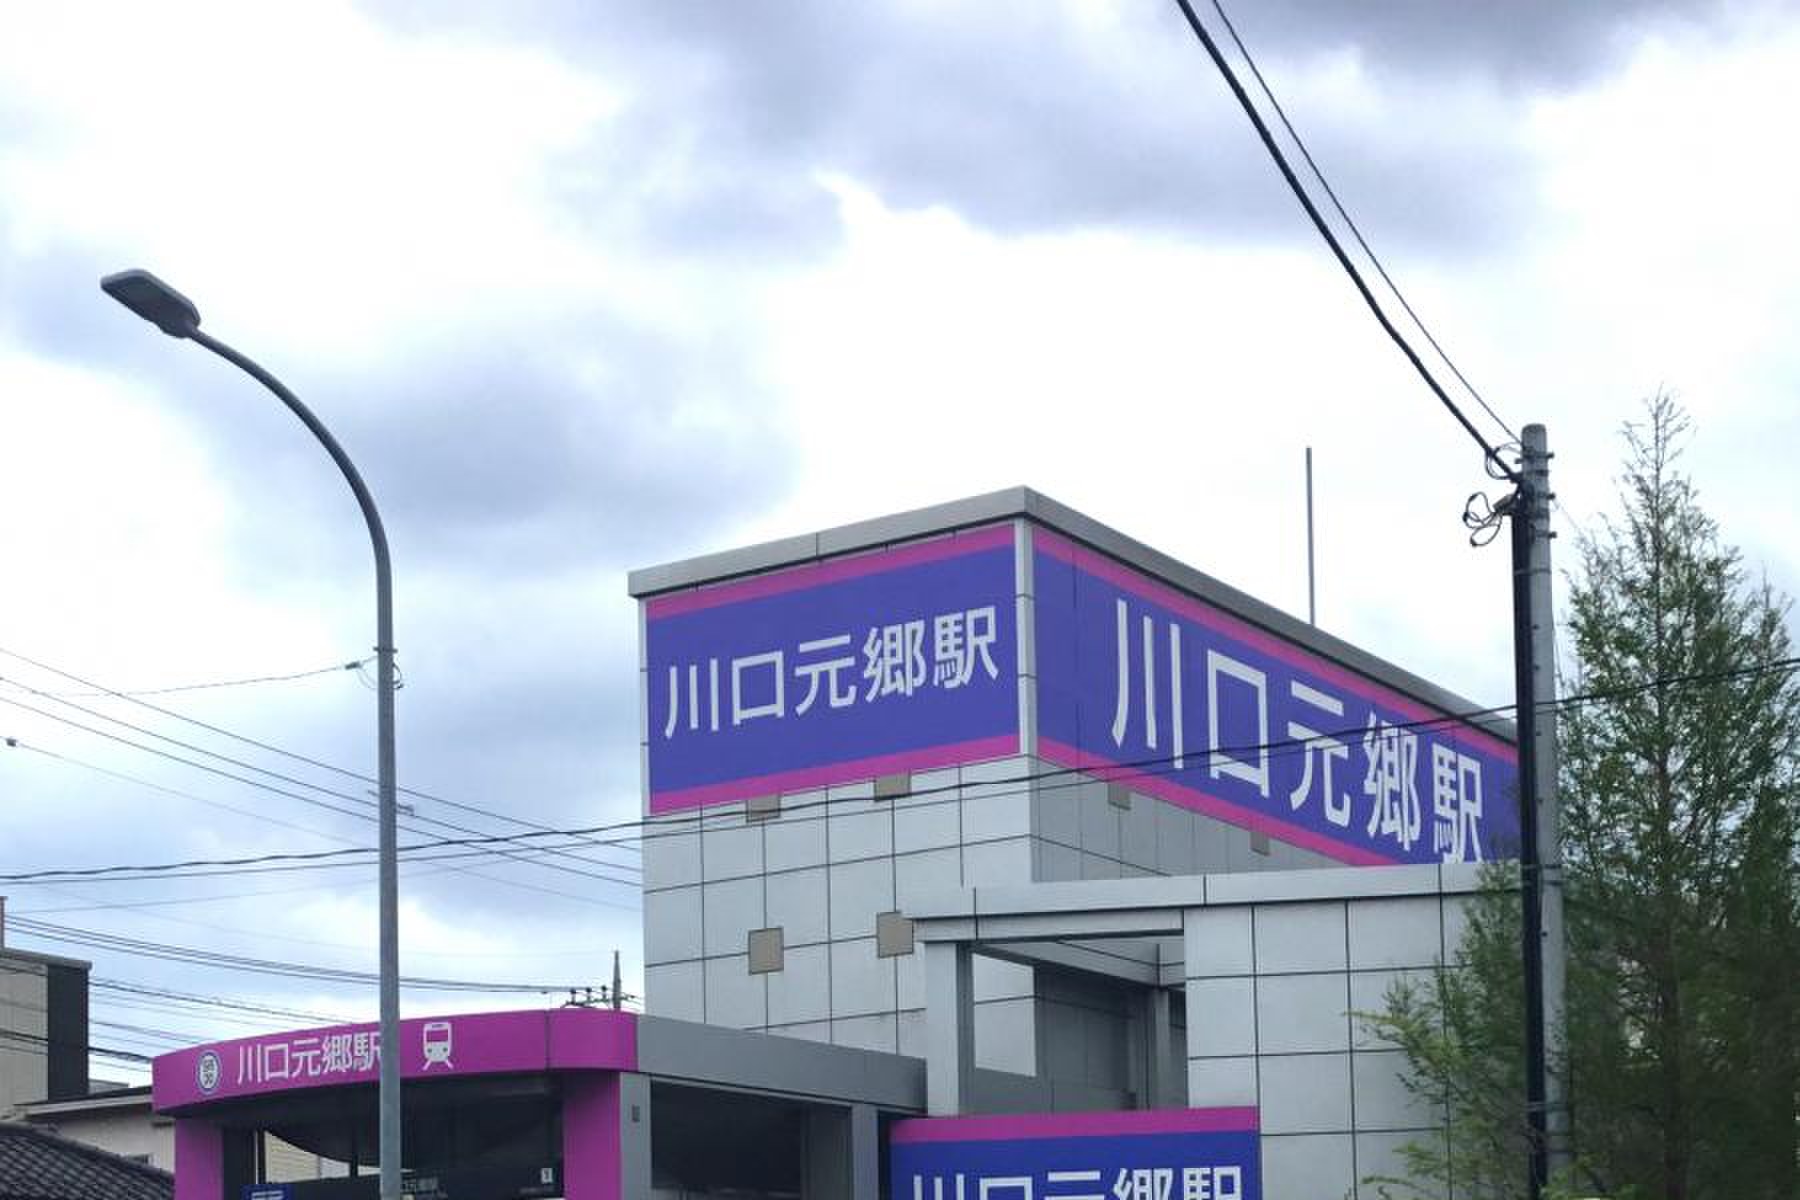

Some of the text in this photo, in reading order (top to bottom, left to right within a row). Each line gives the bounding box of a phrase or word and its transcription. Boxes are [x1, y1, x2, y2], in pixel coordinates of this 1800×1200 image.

[664, 605, 999, 739] 川口元郷駅
[1111, 598, 1484, 865] 川口元郷駅
